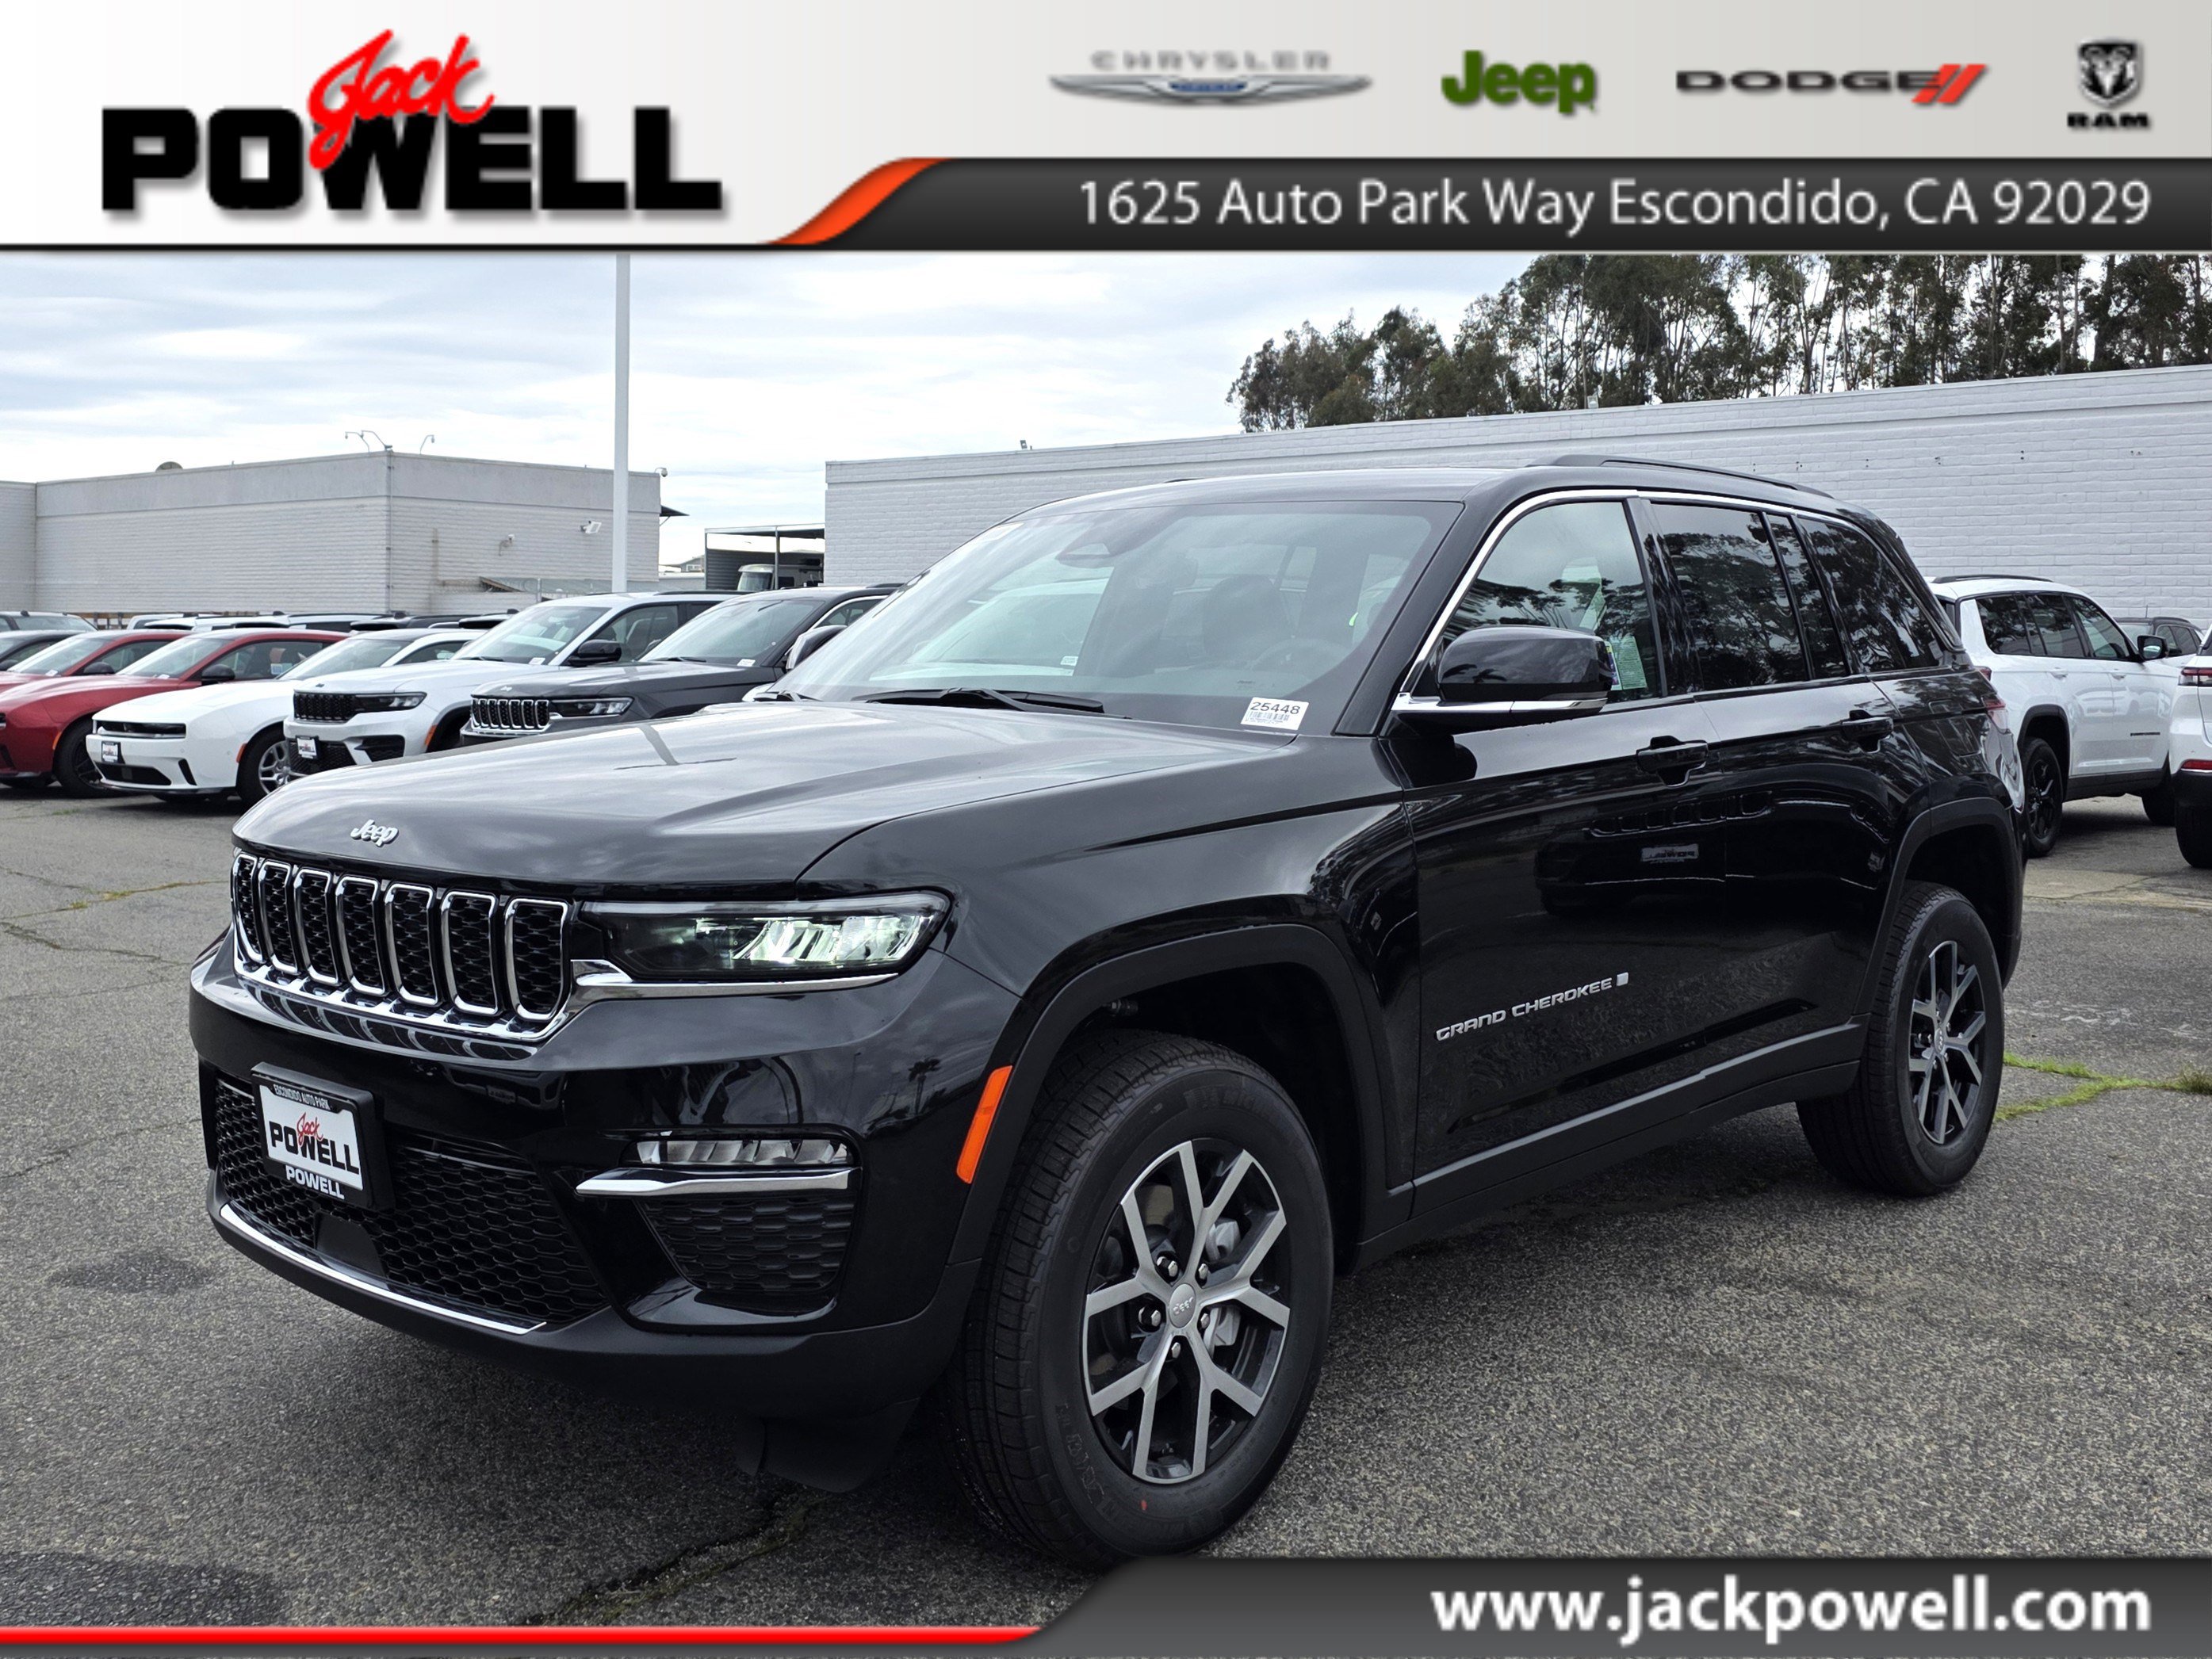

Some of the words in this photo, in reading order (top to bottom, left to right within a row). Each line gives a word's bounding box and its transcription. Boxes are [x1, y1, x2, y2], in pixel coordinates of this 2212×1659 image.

[1250, 701, 1301, 714] 25448
[350, 819, 399, 847] Jeep
[1436, 1010, 1506, 1042] GRAND
[1511, 977, 1613, 1017] CHEROKEE
[297, 1112, 323, 1146] Jack
[269, 1121, 360, 1175] POWELL
[285, 1165, 345, 1200] POWELL
